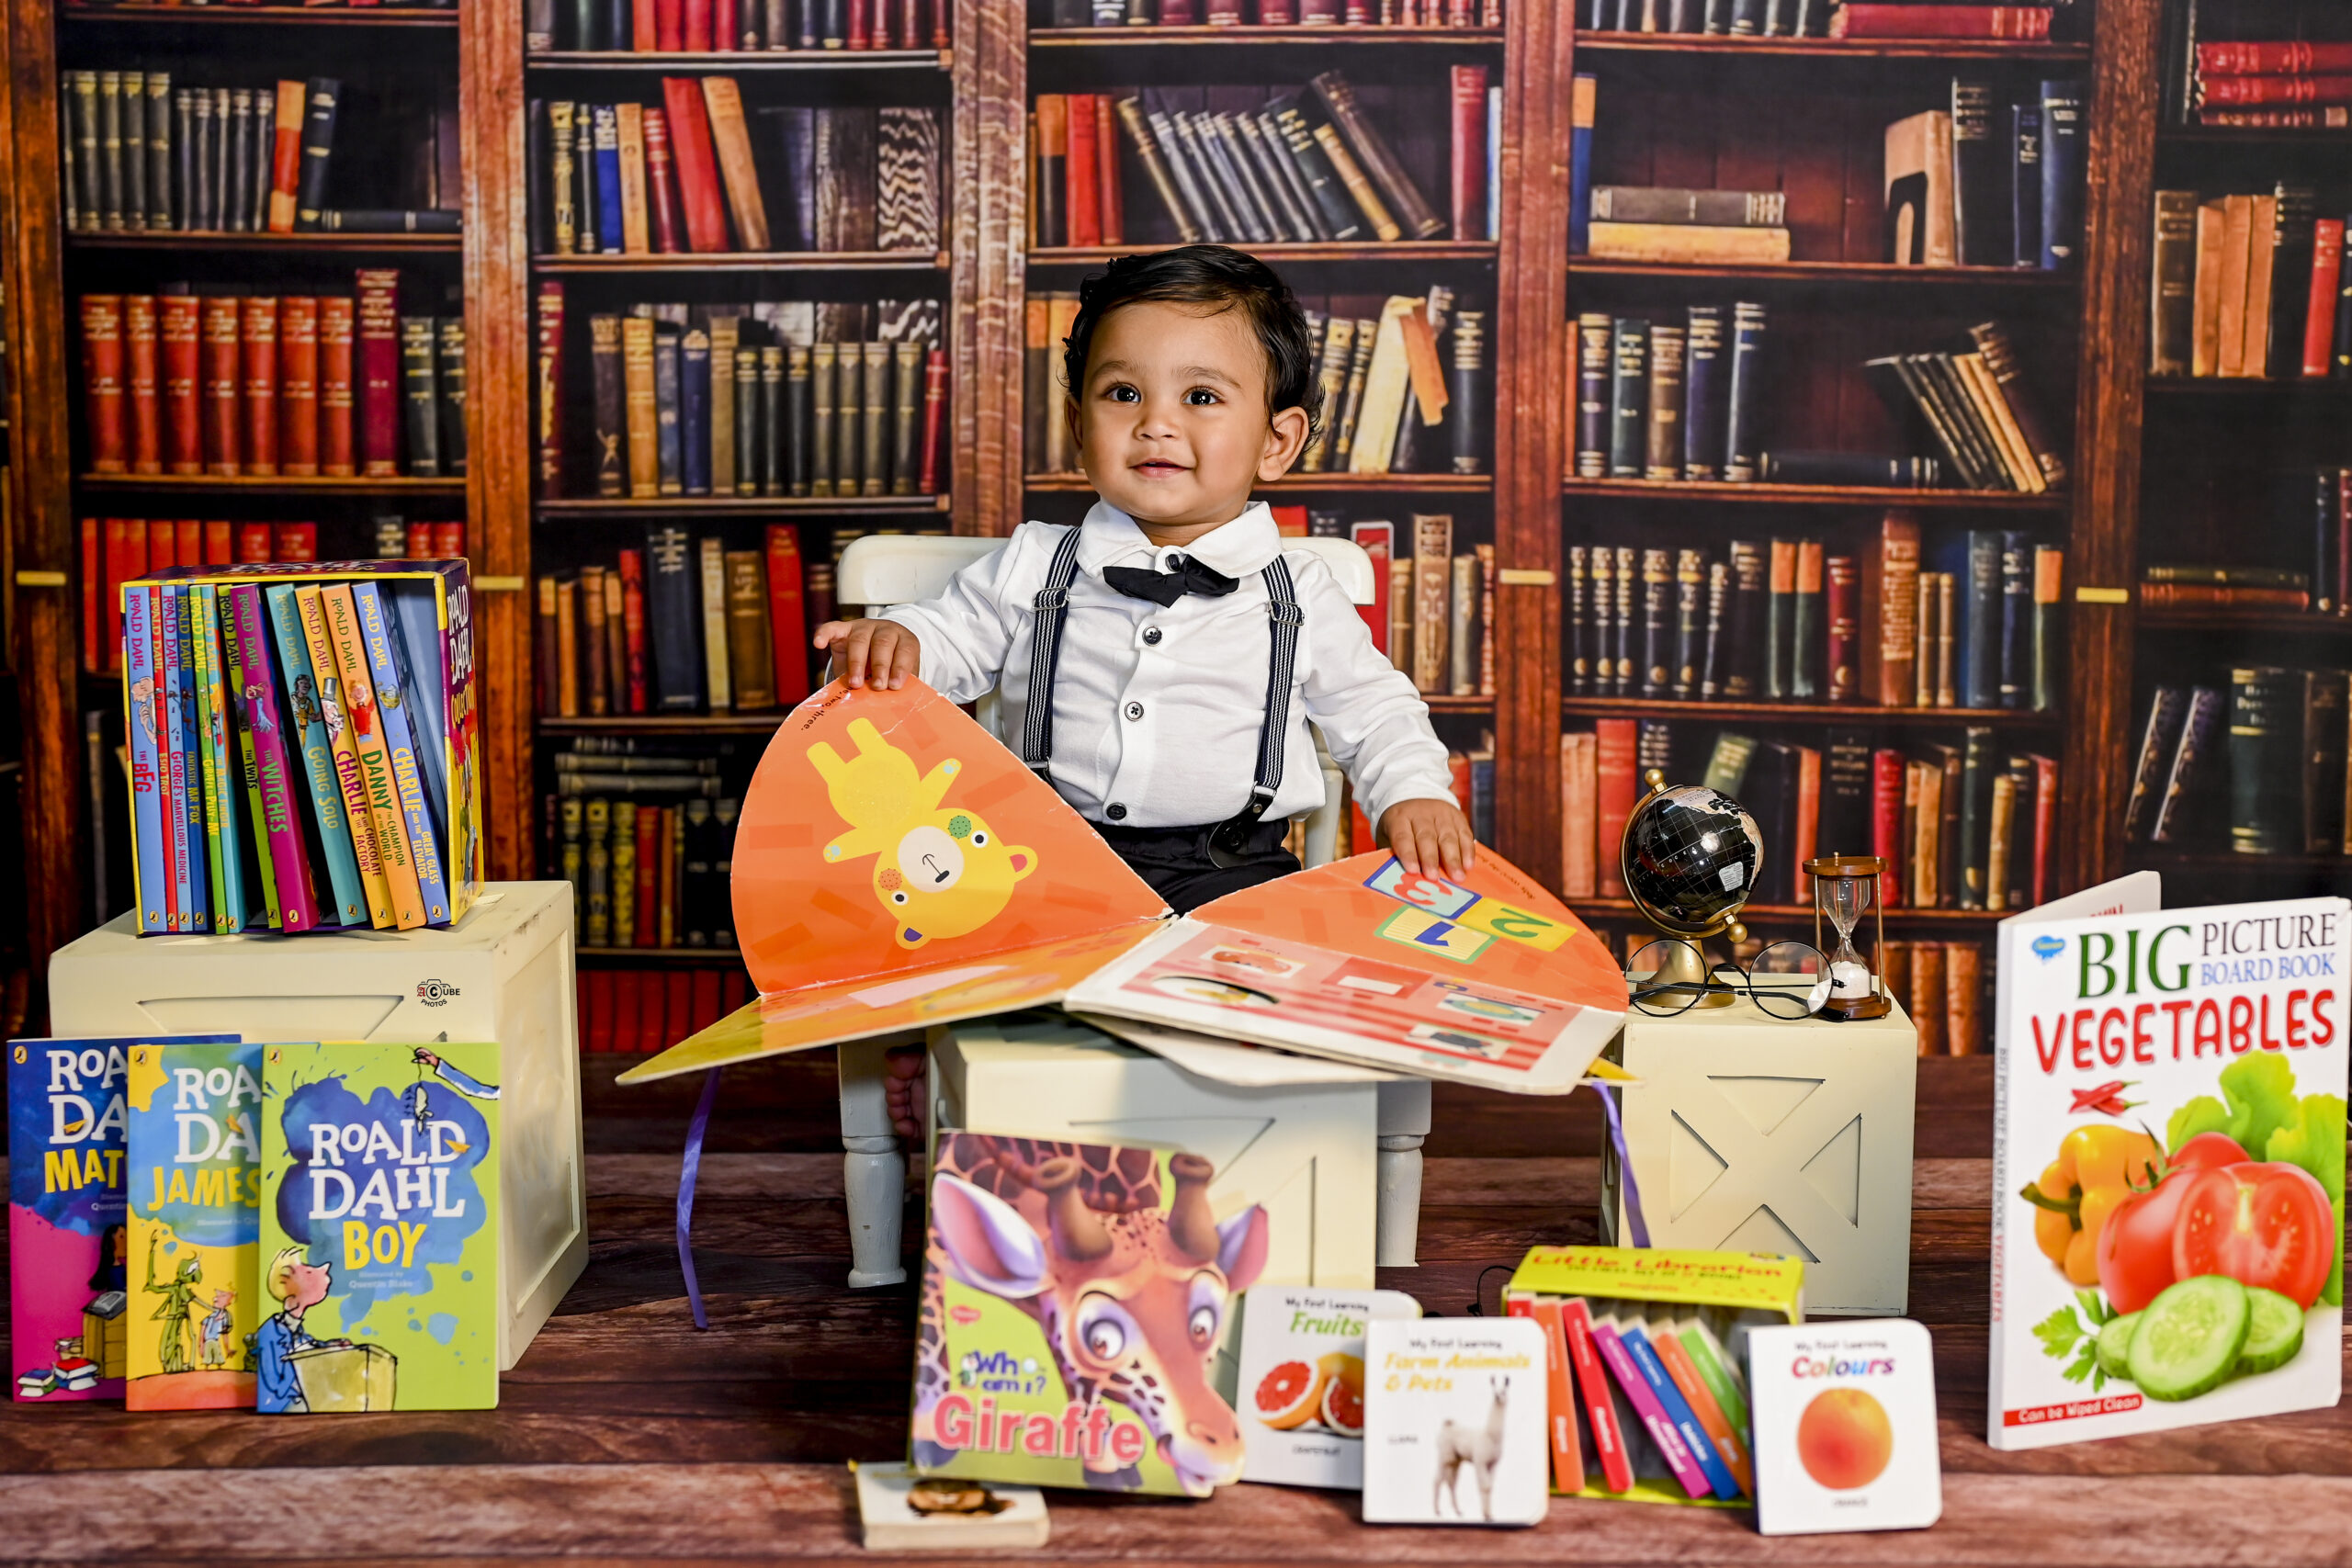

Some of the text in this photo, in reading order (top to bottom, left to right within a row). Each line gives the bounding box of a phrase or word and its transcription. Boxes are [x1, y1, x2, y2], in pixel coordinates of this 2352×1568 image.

[130, 594, 144, 671] ROALD DAHL
[151, 597, 164, 673] ROALD DAHL
[164, 595, 178, 671] ROALD DAHL
[177, 595, 192, 671] ROALD DAHL
[190, 596, 207, 673] ROALD DAHL
[202, 598, 217, 675] ROALD DAHL
[220, 595, 241, 671] ROALD DAHL
[237, 594, 259, 670] ROALD DAHL
[276, 593, 302, 669] ROALD DAHL
[303, 597, 330, 672] ROALD DAHL
[332, 598, 357, 673] ROALD DAHL
[361, 593, 388, 671] ROALD DAHL
[447, 585, 469, 636] ROALD
[449, 627, 472, 685] DAHL
[133, 763, 155, 793] BFG
[187, 751, 200, 824] FANTASTIC MR FOX
[217, 768, 227, 795] MAGIC
[245, 761, 257, 789] TWITS
[261, 750, 288, 832] THE WITCHES
[308, 746, 339, 829] GOING SOLO
[336, 750, 368, 816] CHARLIE
[362, 750, 392, 810] DANNY
[393, 748, 422, 812] CHARLIE
[171, 751, 187, 885] GEORGE'S MARVELLOUS MEDICINE
[379, 829, 392, 861] WORLD
[388, 821, 406, 866] CHAMPION
[356, 828, 382, 877] CHOCOLATE FACTORY
[413, 840, 428, 879] ELEVATOR
[421, 831, 439, 885] GREAT GLASS
[1393, 872, 1453, 906] 3
[1414, 920, 1455, 947] 1
[1490, 908, 1554, 939] 2
[2076, 913, 2337, 999] BIG PICTURE
[2200, 952, 2336, 987] BOARD BOOK
[2030, 988, 2335, 1074] VEGETABLES
[1996, 1075, 2007, 1134] PICTURE
[174, 1112, 261, 1163] DA
[309, 1119, 468, 1167] ROALD
[1995, 1138, 2006, 1186] BOARD
[147, 1166, 261, 1212] JAMES
[309, 1166, 466, 1221] DAHL
[343, 1220, 427, 1270] BOY
[1992, 1234, 2004, 1323] VEGETABLES
[1290, 1310, 1365, 1337] Fruits
[1329, 1299, 1369, 1313] Learning
[1385, 1352, 1531, 1370] Farm Animals
[1458, 1338, 1502, 1349] Learning
[1792, 1356, 1896, 1379] Colours
[982, 1380, 1019, 1392] am
[1408, 1374, 1453, 1392] Pets
[2018, 1397, 2140, 1423] Can be Wiped Clean
[933, 1394, 1147, 1463] Giraffe
